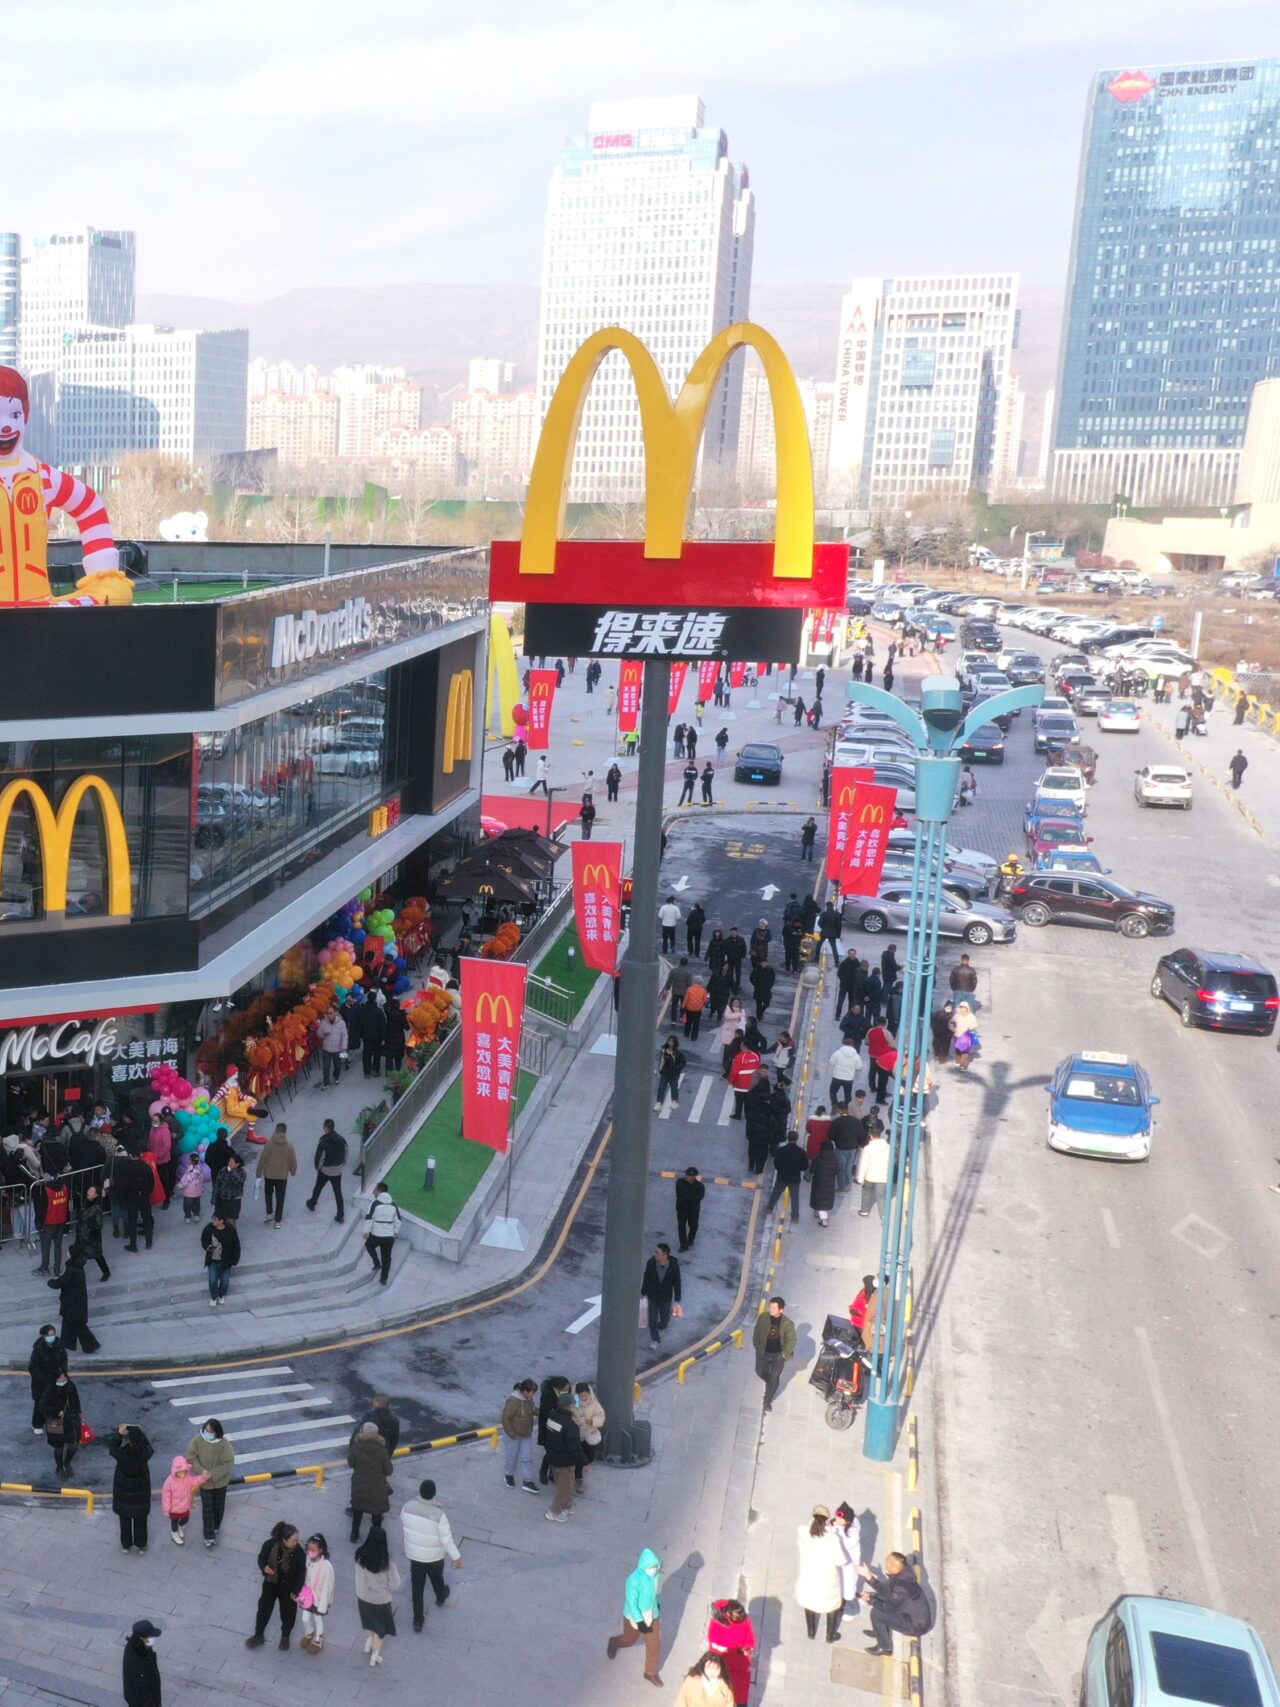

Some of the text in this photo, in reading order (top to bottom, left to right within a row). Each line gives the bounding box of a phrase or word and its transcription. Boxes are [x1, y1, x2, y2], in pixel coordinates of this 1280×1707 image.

[1159, 66, 1256, 87] 国家能源集团
[1159, 84, 1238, 98] CHN ENERGY
[593, 134, 633, 149] CMG
[854, 340, 868, 386] 中国铁塔
[838, 340, 853, 421] CHINA TOWER
[271, 597, 372, 668] McDonald's
[590, 611, 731, 656] 得来速
[111, 1037, 179, 1061] 大美青海
